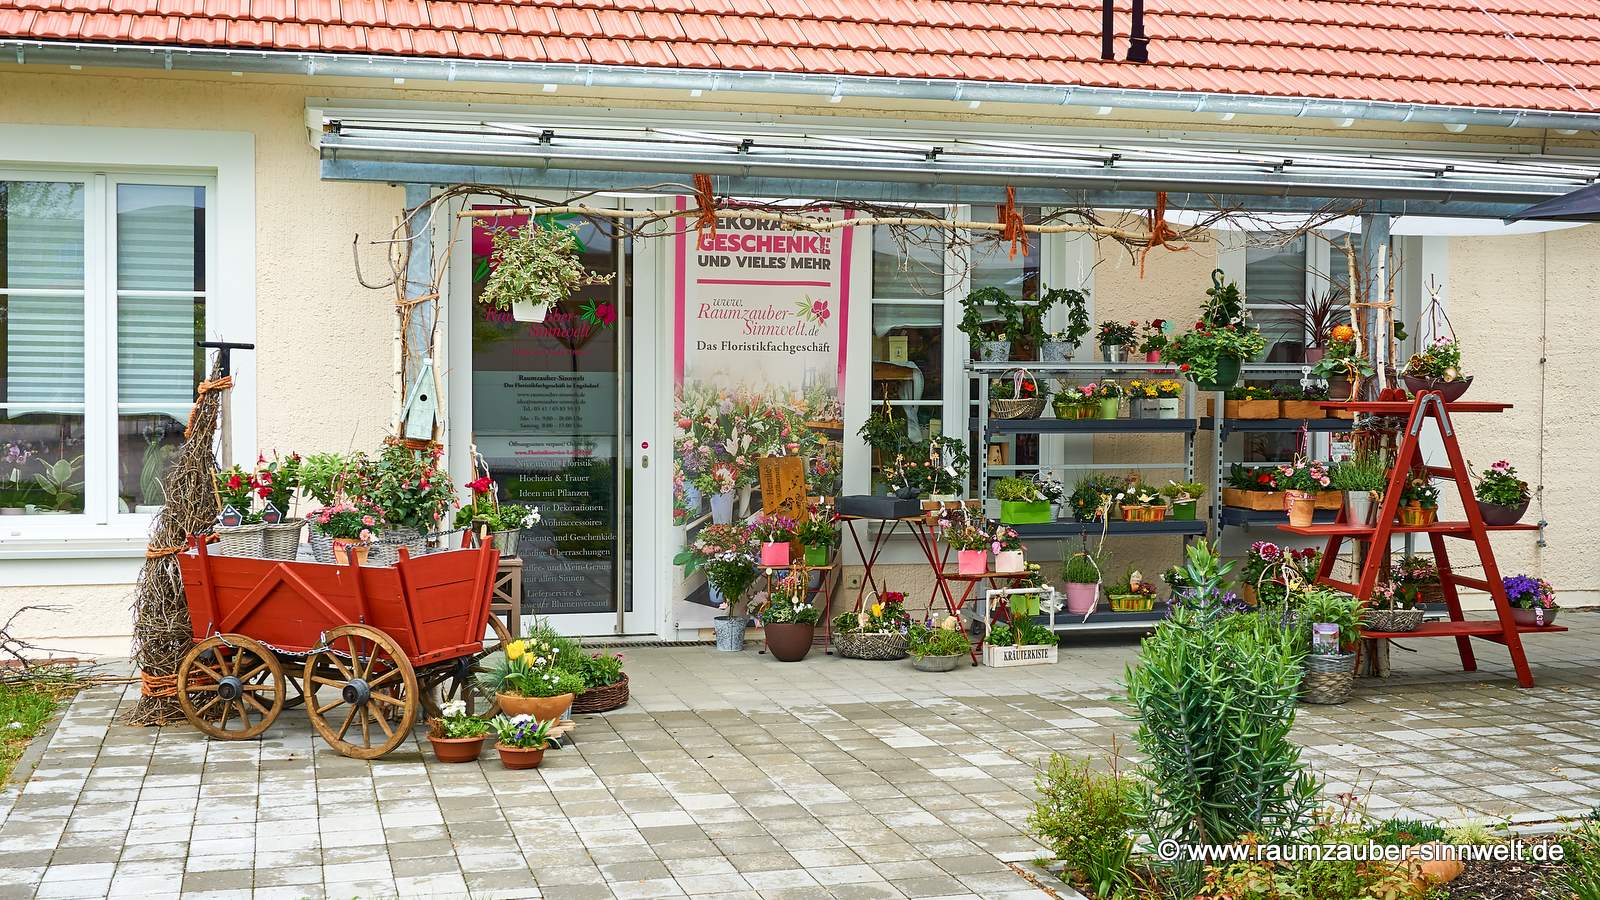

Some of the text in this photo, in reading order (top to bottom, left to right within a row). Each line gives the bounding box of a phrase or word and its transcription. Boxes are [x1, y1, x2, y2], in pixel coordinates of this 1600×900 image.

[700, 234, 831, 254] GESCHENKE
[698, 255, 831, 270] UND VIELES MEHR
[742, 319, 820, 336] Sinnwelt.de
[697, 341, 831, 354] Das Floristikfachgeschäft
[562, 459, 593, 467] Floristik
[519, 474, 553, 482] Hochzeit
[563, 474, 590, 482] Trauer
[519, 489, 589, 497] Ideen mit Pflanzen
[553, 533, 568, 541] und
[549, 548, 611, 556] Überraschungen
[558, 574, 585, 582] Sinnen
[1003, 649, 1049, 661] KRÄUTERKISTE
